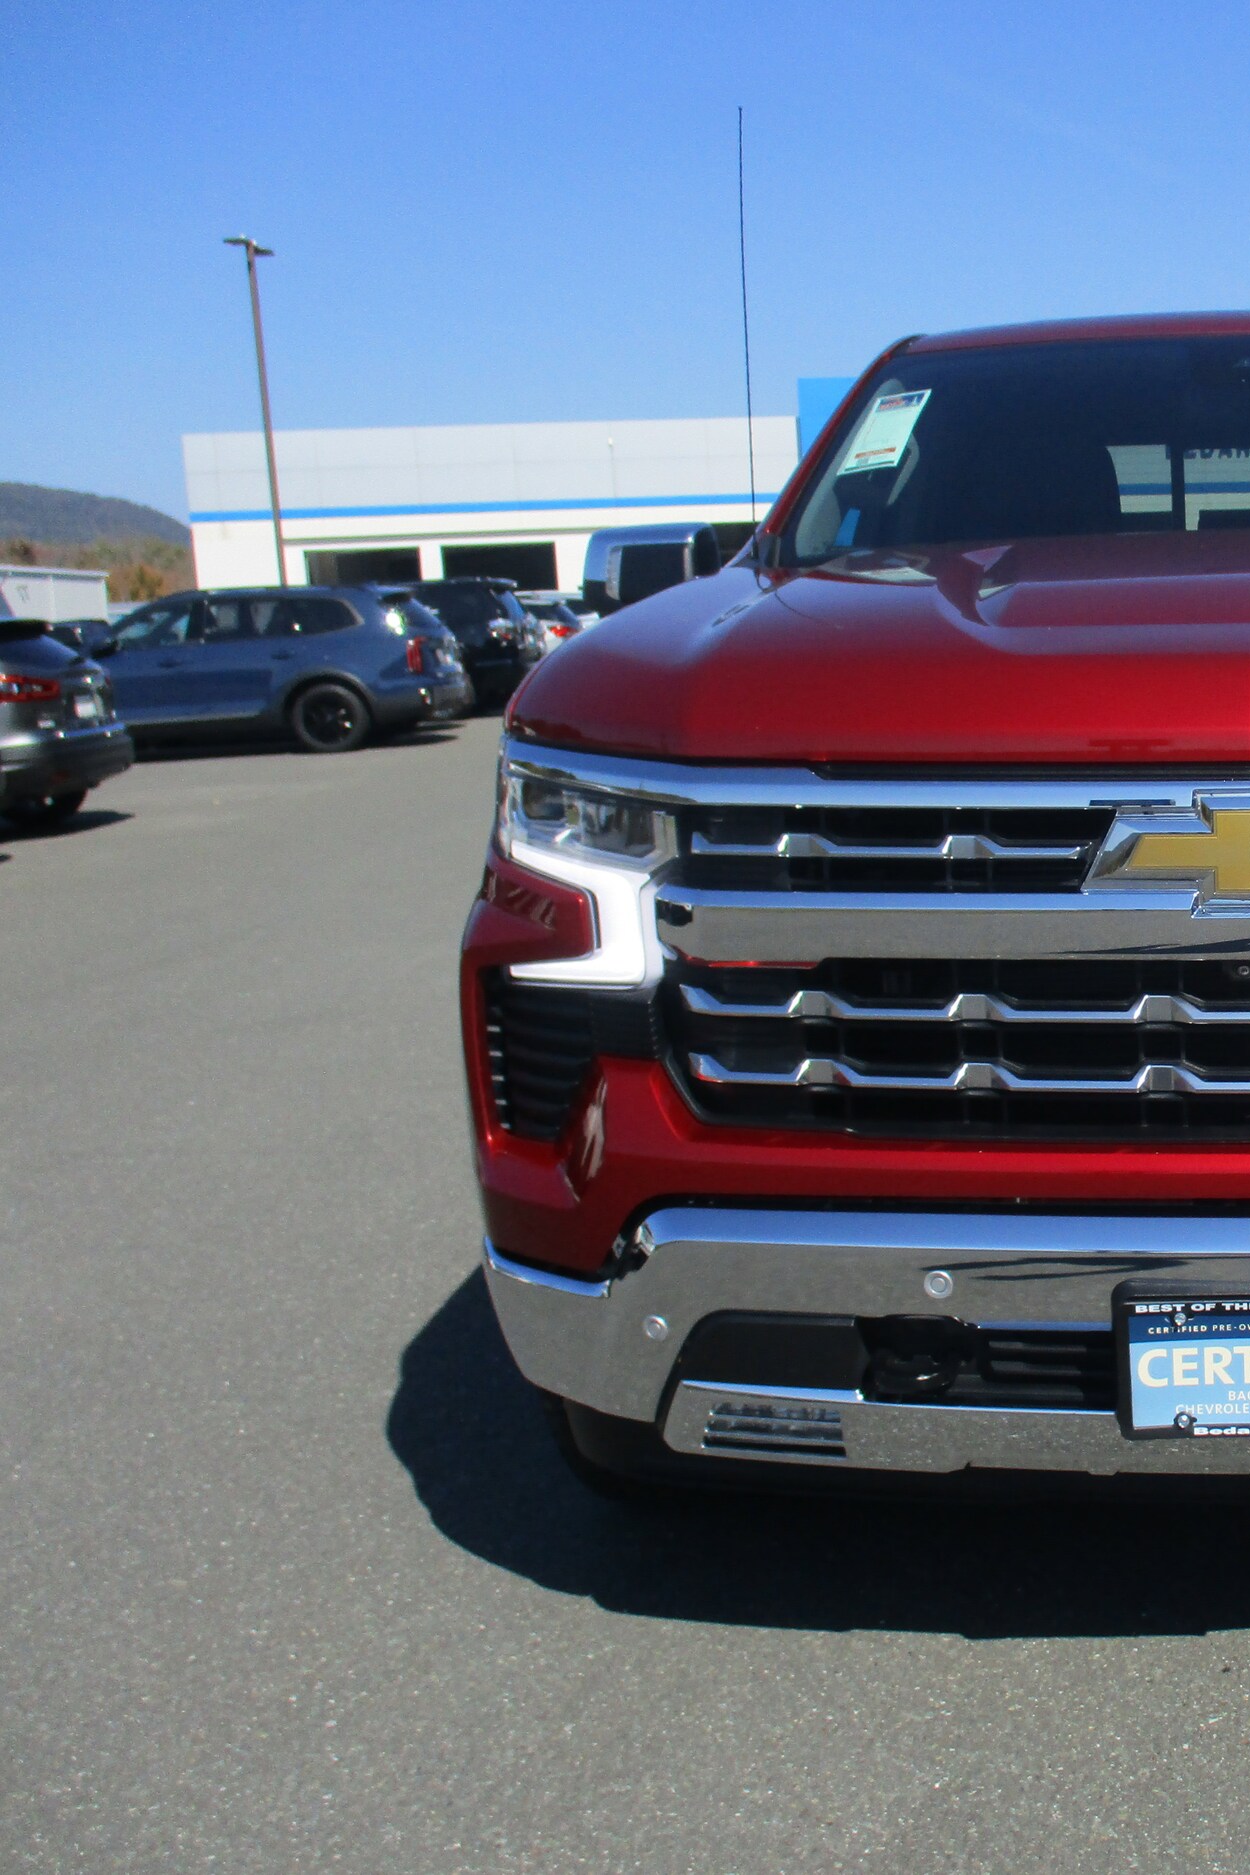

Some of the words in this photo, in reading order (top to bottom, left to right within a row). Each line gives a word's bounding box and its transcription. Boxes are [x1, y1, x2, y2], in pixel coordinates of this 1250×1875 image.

[1135, 1303, 1185, 1314] BEST
[1190, 1303, 1216, 1312] OF
[1148, 1325, 1208, 1335] CERTIFIED
